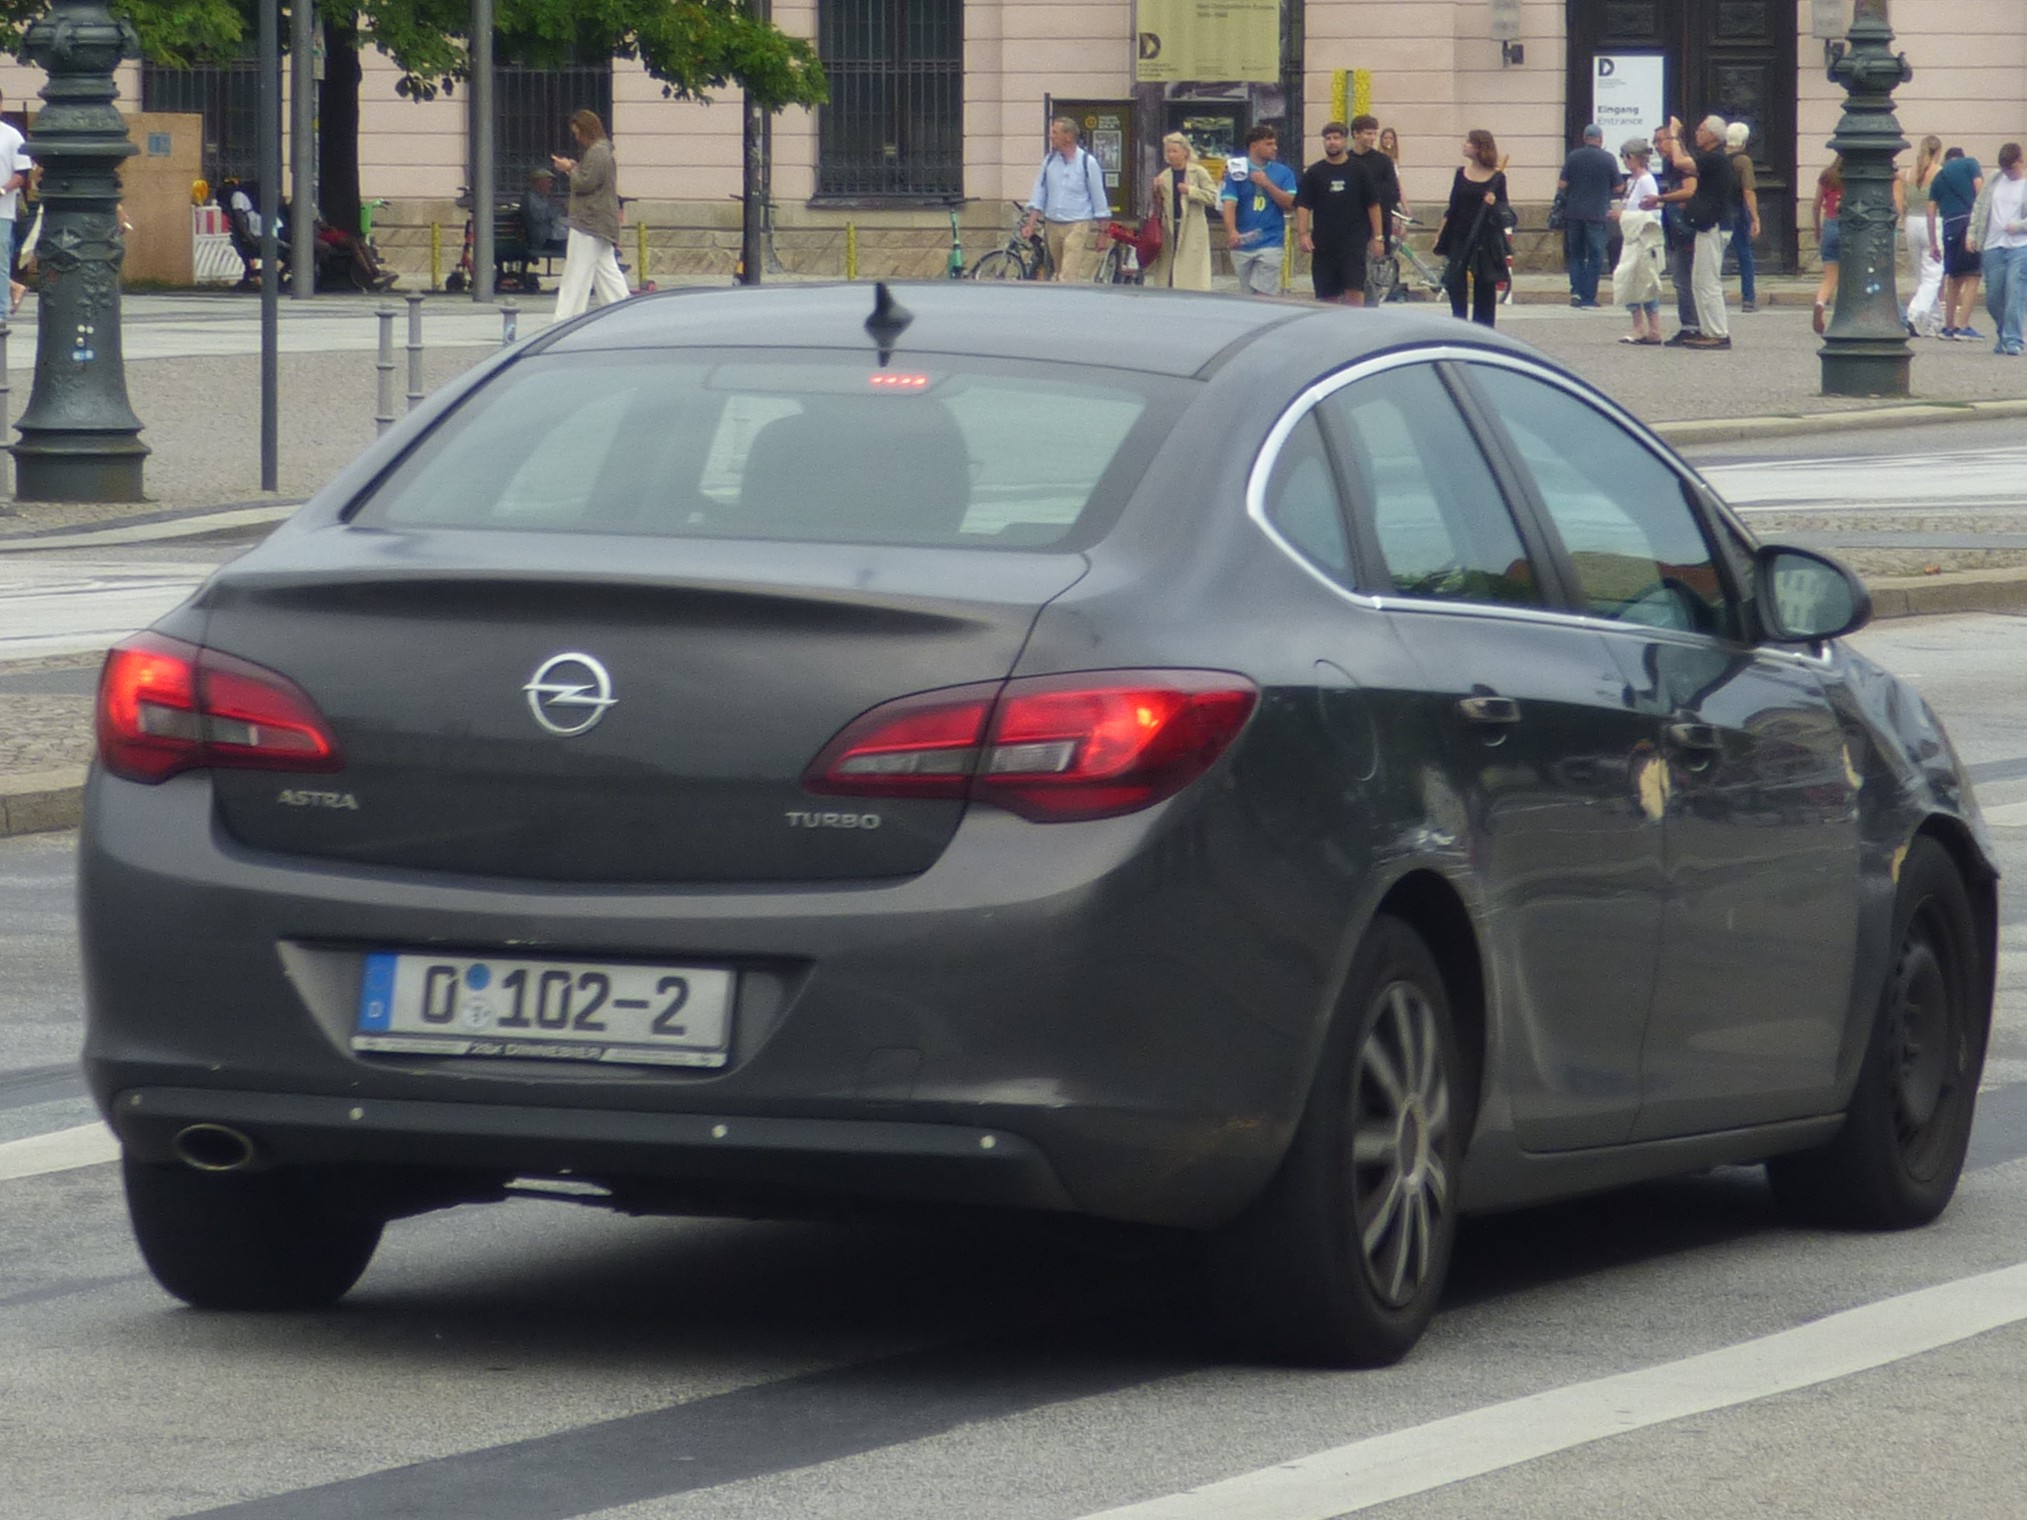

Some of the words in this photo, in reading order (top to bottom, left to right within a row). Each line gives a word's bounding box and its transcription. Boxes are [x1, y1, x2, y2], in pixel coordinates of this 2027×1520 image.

[1598, 106, 1639, 115] Eingang
[1598, 117, 1643, 125] Entrance
[1253, 196, 1266, 211] 10
[278, 790, 359, 810] ASTRA
[785, 812, 881, 829] TURBO
[497, 969, 689, 1036] 102-2
